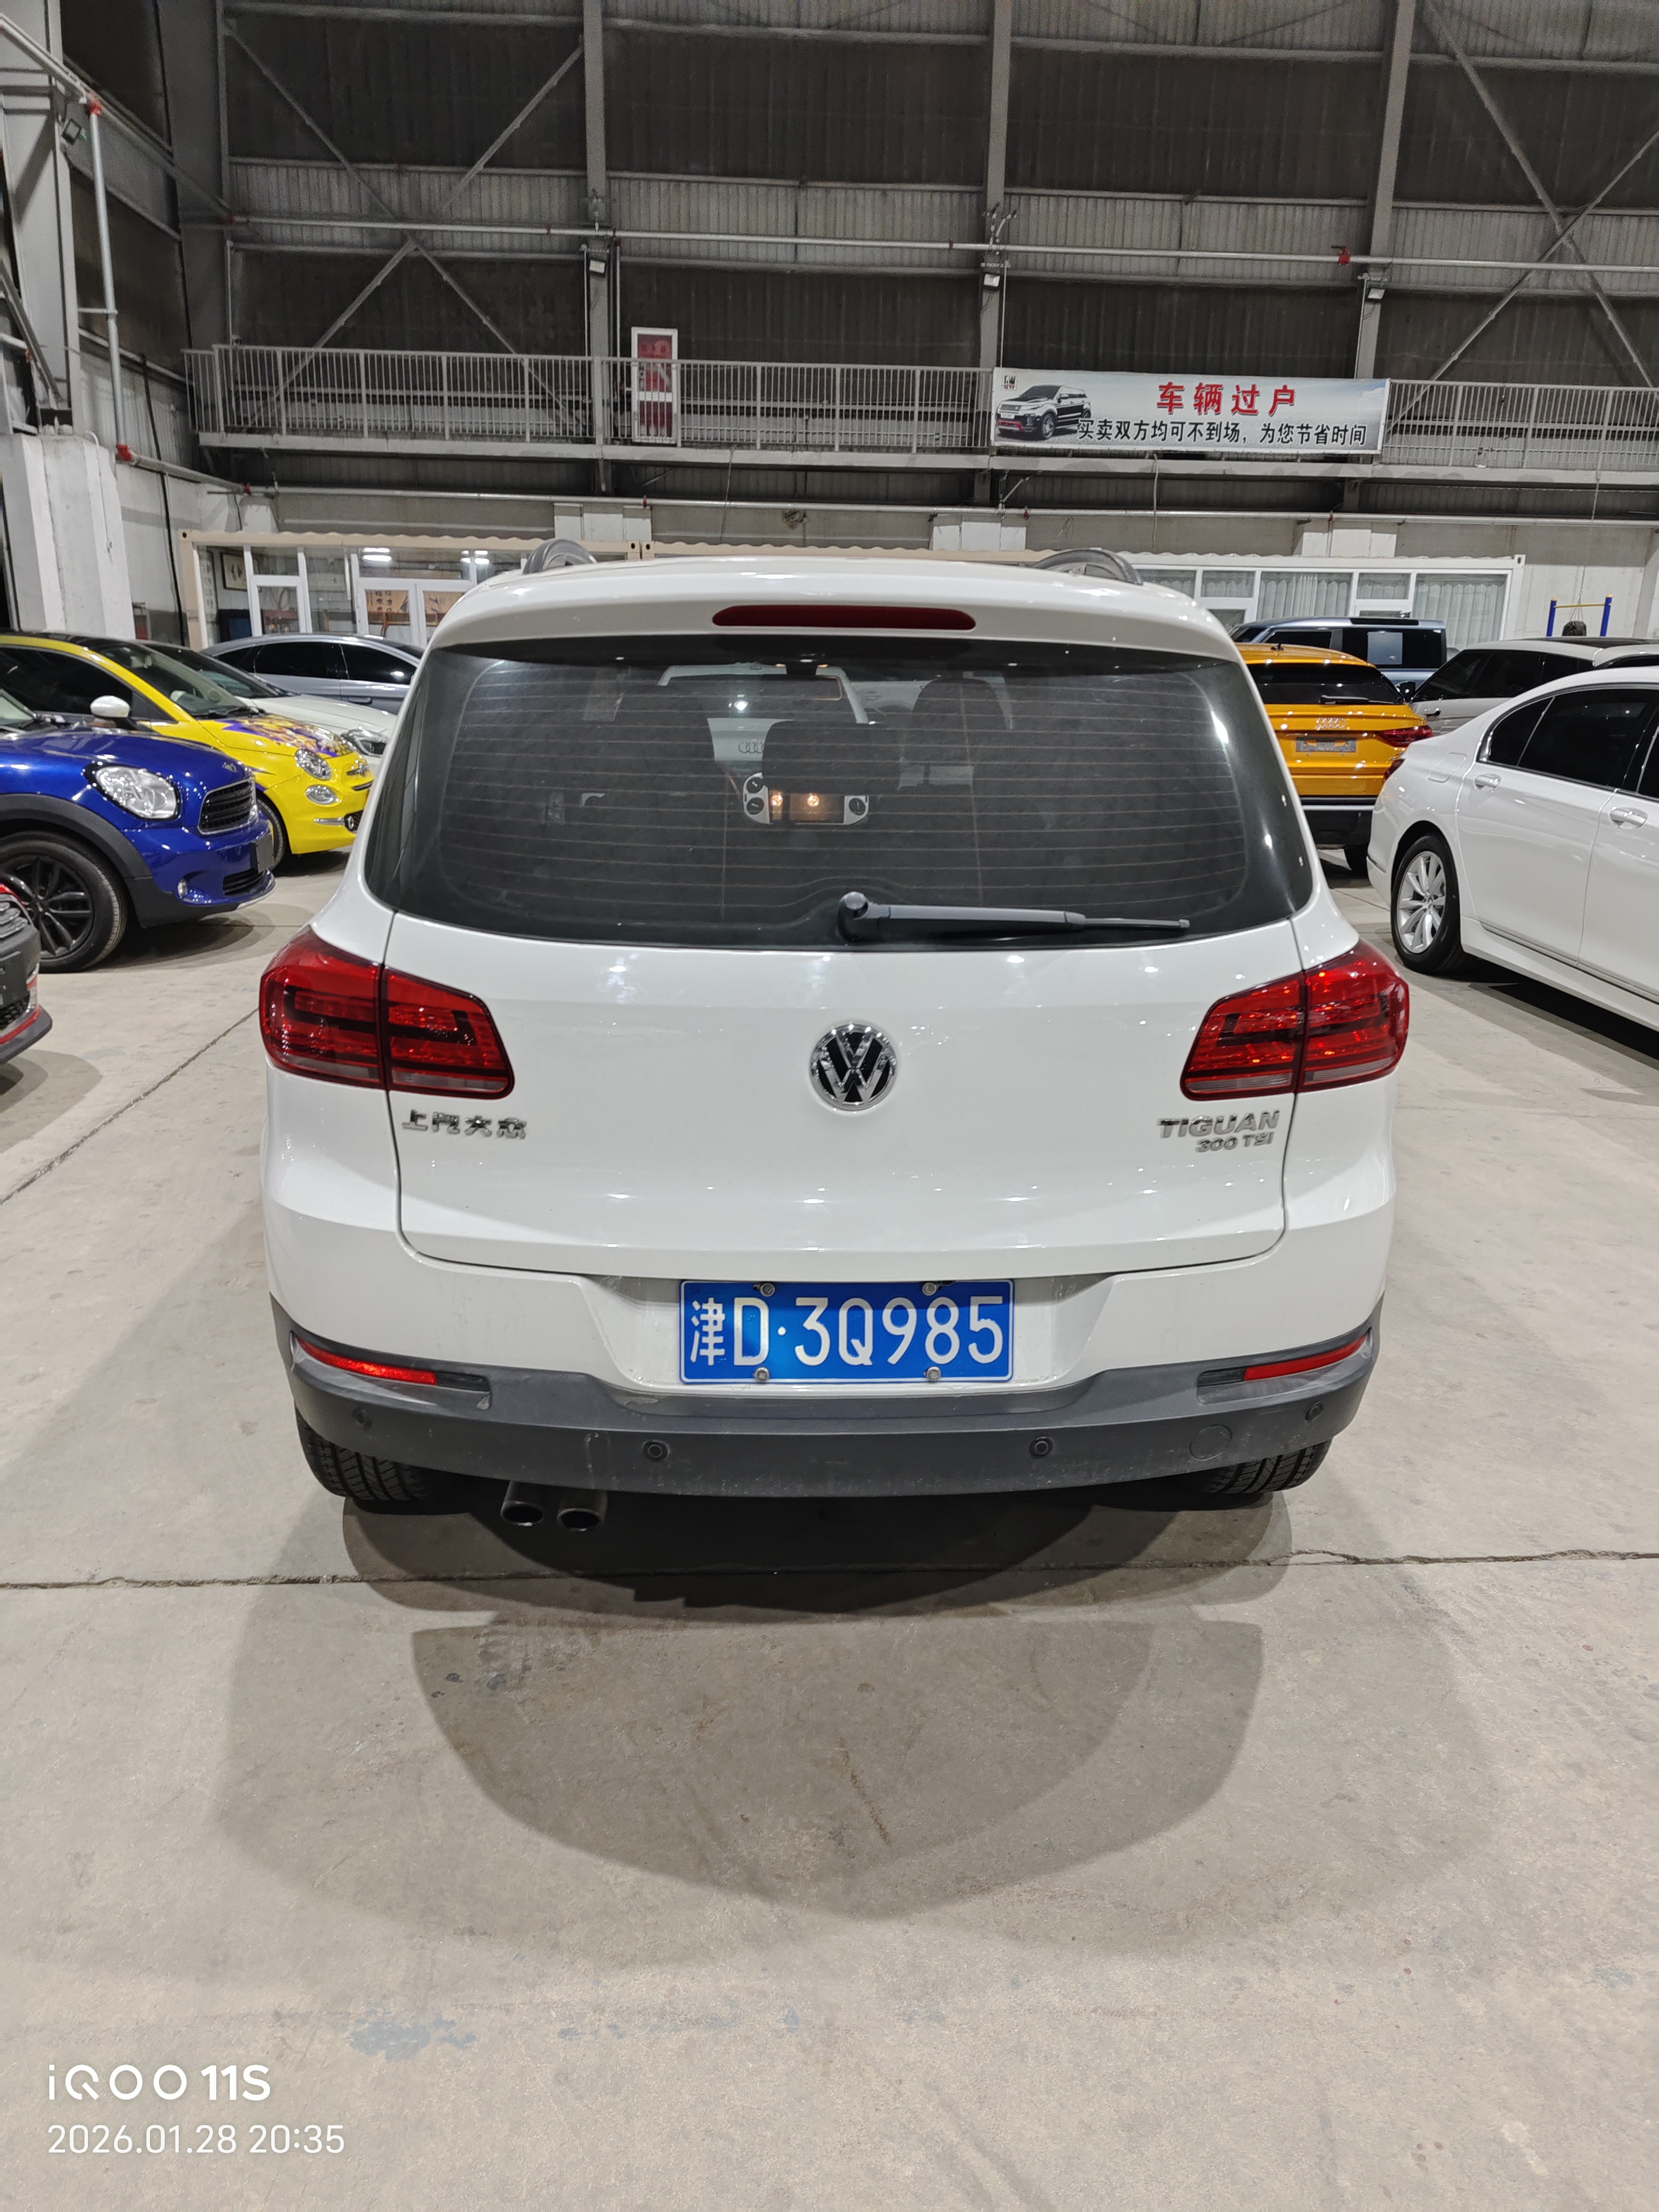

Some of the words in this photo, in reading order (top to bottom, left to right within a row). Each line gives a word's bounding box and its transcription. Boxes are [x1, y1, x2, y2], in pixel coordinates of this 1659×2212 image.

[1157, 382, 1297, 416] 车辆过户
[1078, 419, 1367, 446] 买卖双方均可不到场，为您节省时间
[1157, 1110, 1280, 1138] TIGUAN
[1195, 1136, 1238, 1152] 300
[1243, 1132, 1274, 1147] TSI
